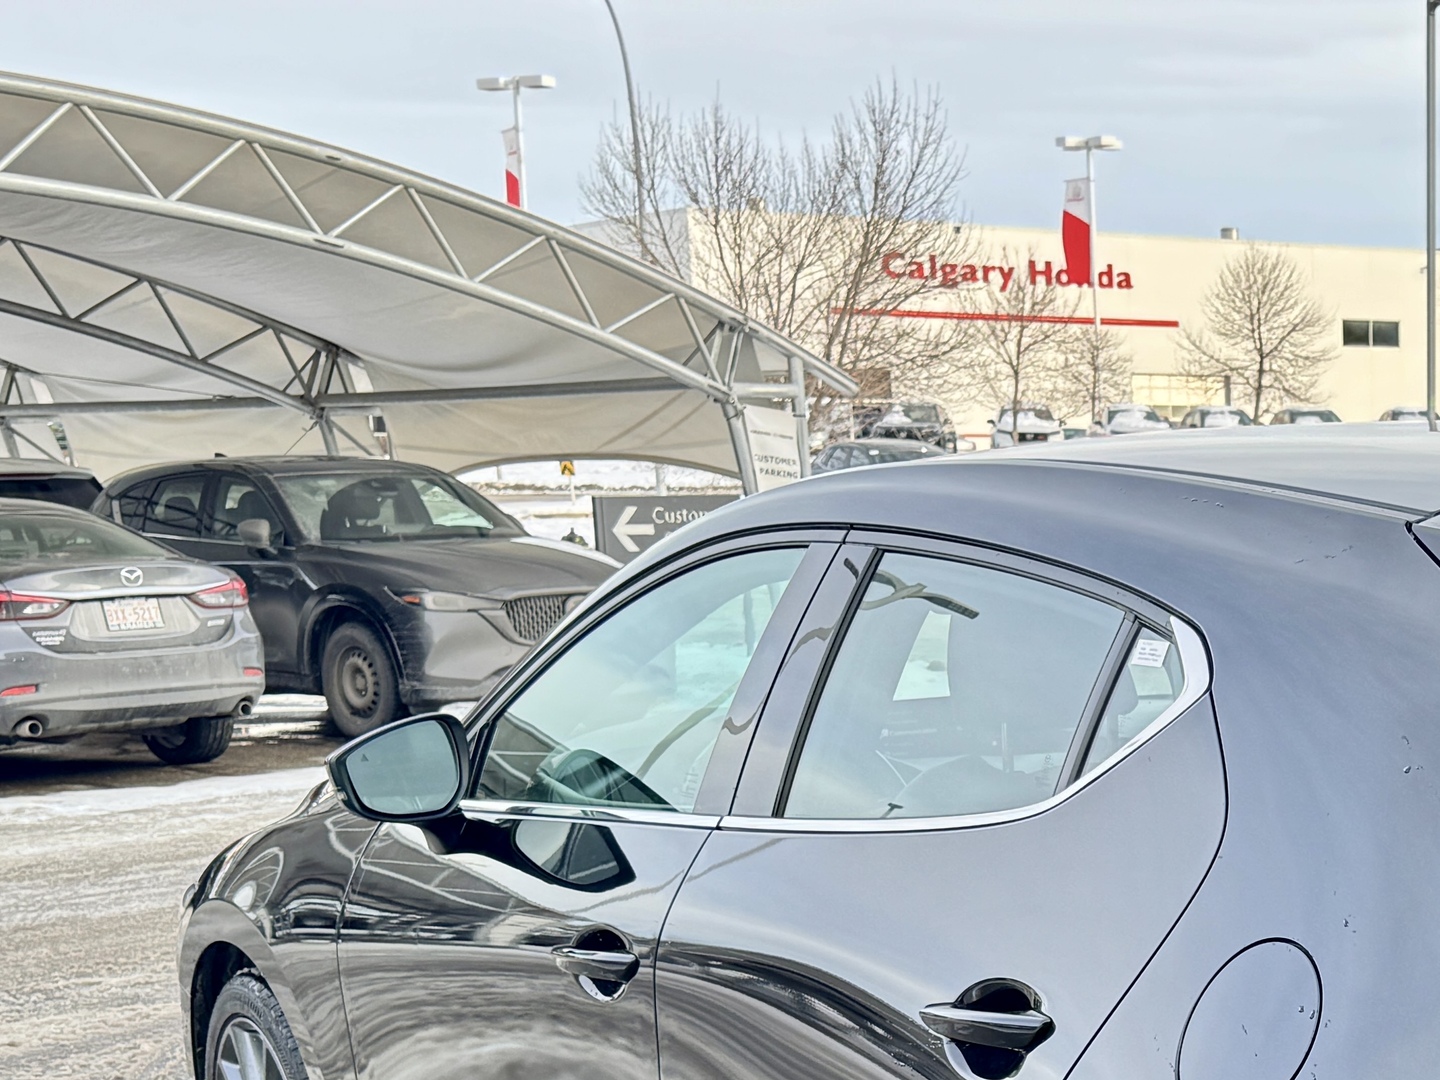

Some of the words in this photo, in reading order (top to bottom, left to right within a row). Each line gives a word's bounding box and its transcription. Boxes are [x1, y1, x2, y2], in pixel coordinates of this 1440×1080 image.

[881, 251, 1015, 293] Calgary
[1029, 260, 1134, 290] Hoda
[754, 453, 797, 467] CUSTOMER
[760, 467, 798, 479] PARKING
[652, 506, 709, 524] Custo
